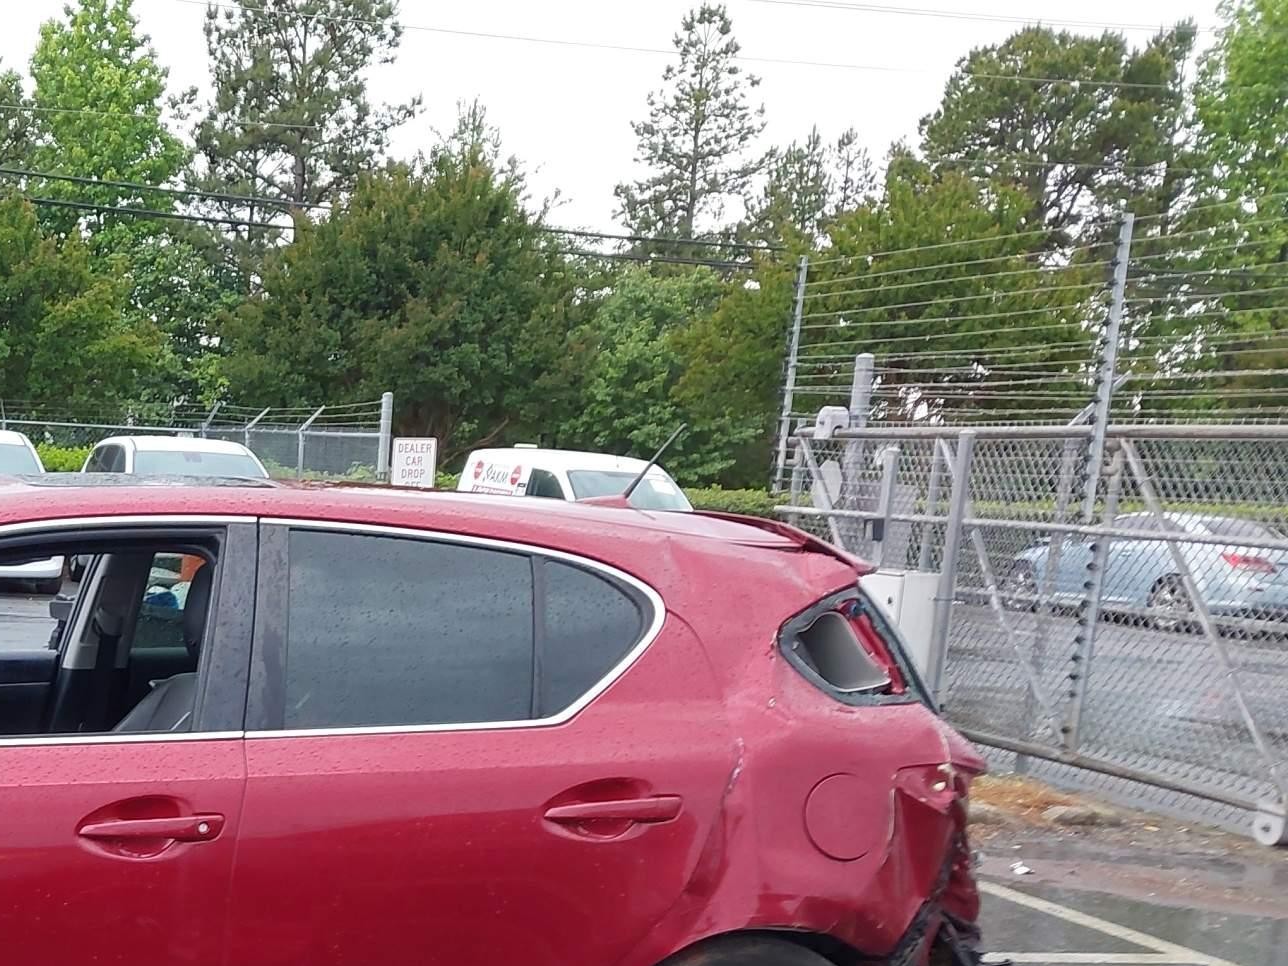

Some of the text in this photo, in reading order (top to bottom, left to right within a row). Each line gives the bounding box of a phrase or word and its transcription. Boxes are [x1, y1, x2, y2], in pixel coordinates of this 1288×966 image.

[398, 443, 432, 454] DEALER
[406, 456, 423, 466] CAR
[401, 468, 426, 479] DROP
